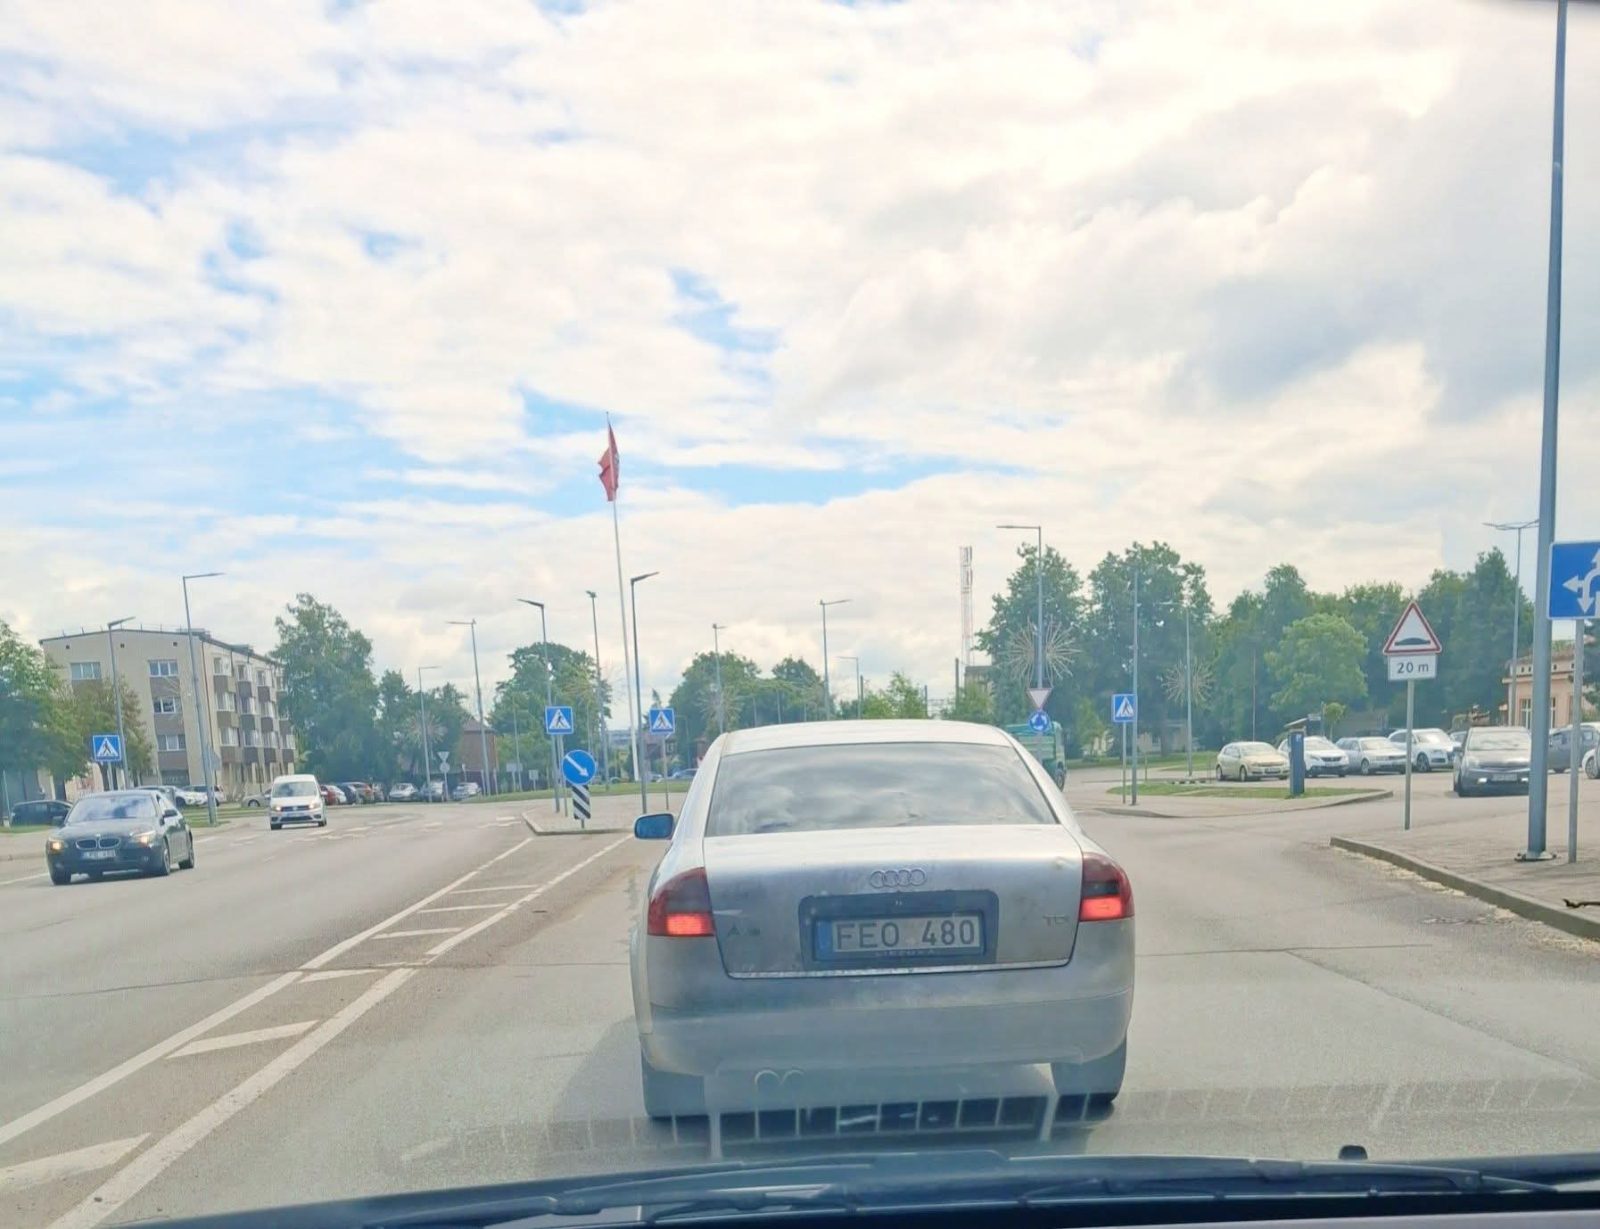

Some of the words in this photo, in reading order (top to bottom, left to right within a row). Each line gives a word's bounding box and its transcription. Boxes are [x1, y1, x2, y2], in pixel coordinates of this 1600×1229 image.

[1396, 661, 1414, 674] 20
[1418, 663, 1429, 673] m
[836, 921, 900, 949] FEO
[921, 918, 975, 946] 480
